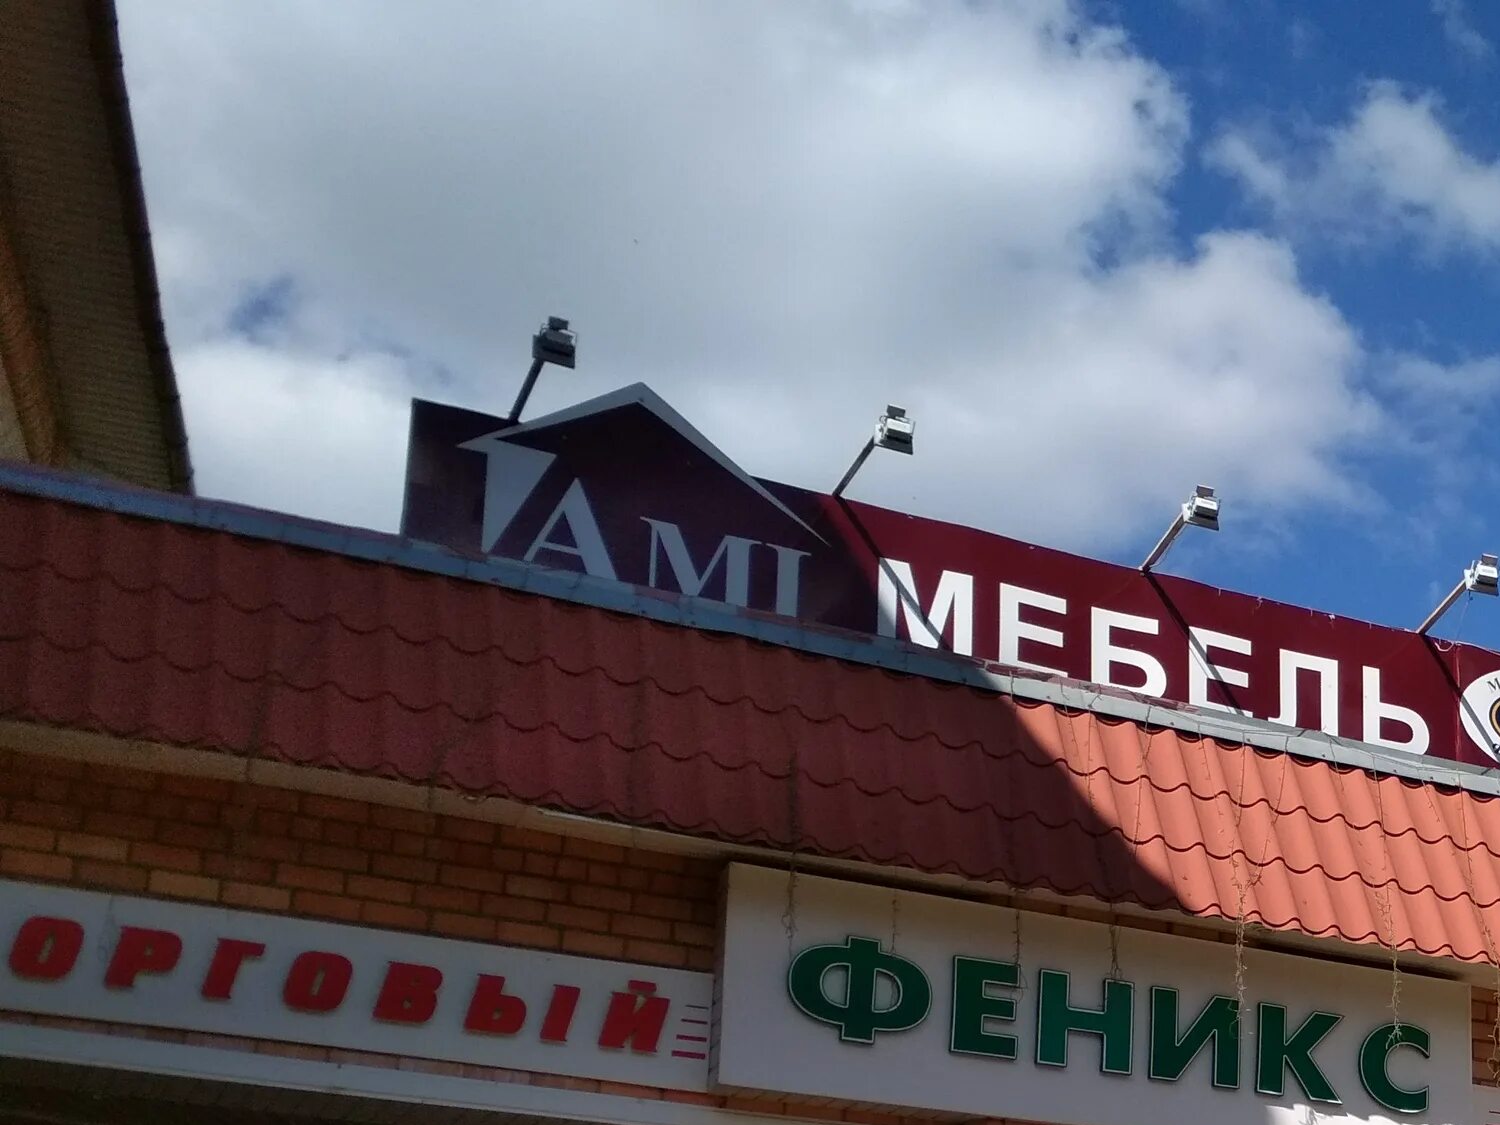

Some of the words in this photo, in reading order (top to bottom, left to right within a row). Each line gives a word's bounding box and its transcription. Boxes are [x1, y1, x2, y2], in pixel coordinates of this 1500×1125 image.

[878, 557, 1431, 755] МЕБЕЛЬ
[8, 915, 670, 1053] ОРГОВЫЙ
[787, 935, 1431, 1114] ФЕНИКС
